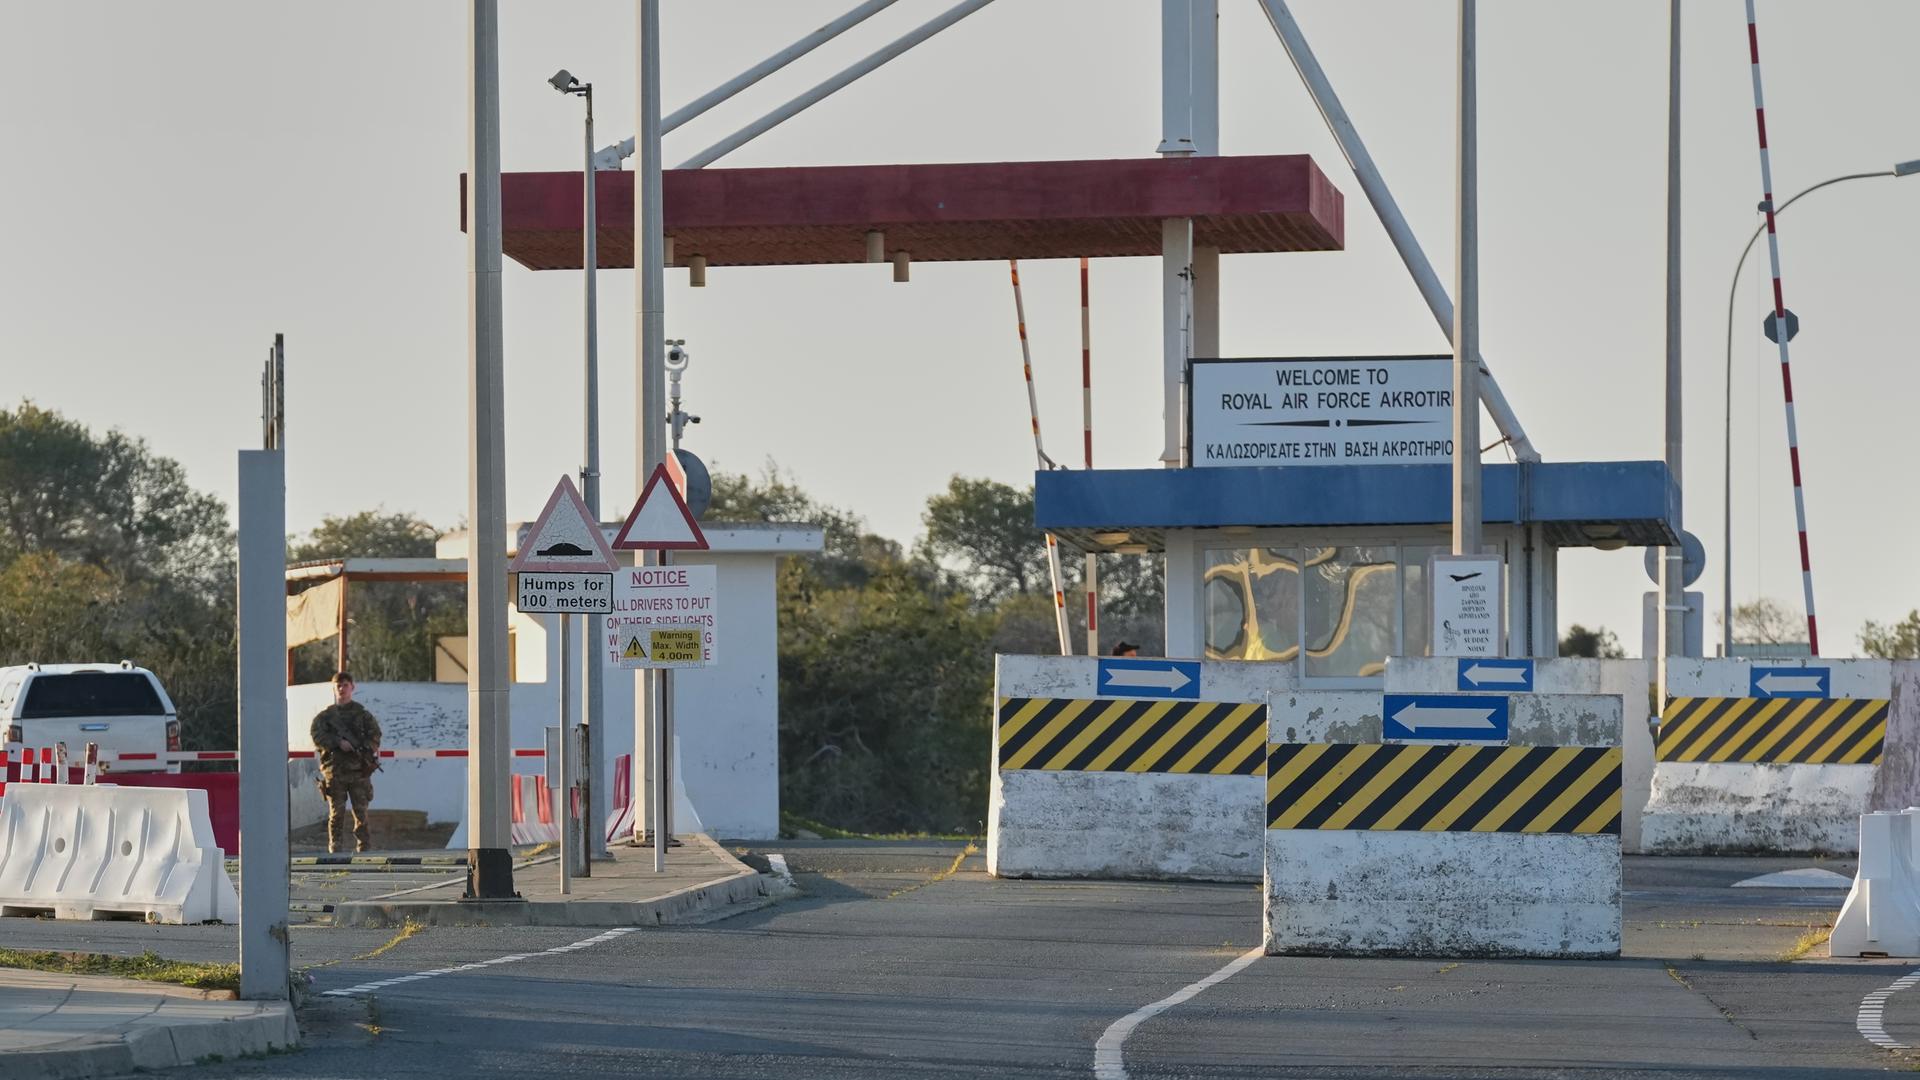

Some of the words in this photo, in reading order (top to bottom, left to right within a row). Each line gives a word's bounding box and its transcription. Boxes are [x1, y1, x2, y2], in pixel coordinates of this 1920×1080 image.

[1276, 369, 1360, 386] WELCOME
[1366, 368, 1388, 385] TO
[1221, 393, 1272, 410] ROYAL
[1281, 392, 1308, 409] AIR
[1318, 392, 1370, 408] FORCE
[1206, 442, 1300, 459] ΚΑΛΩΣΟΡΙΣΑΤΕ
[1304, 442, 1336, 458] ΣΤΗΝ
[1345, 441, 1378, 457] ΒΑΣΗ
[632, 571, 687, 585] NOTICE
[524, 578, 575, 593] Humps
[584, 578, 604, 591] for
[521, 595, 547, 607] 100
[557, 595, 607, 608] meters
[630, 598, 673, 611] DRIVERS
[675, 598, 689, 610] TO
[691, 597, 711, 609] PUT
[659, 631, 693, 640] Warning
[652, 642, 672, 650] Max.
[675, 641, 699, 649] Width
[658, 652, 693, 660] 4.00m
